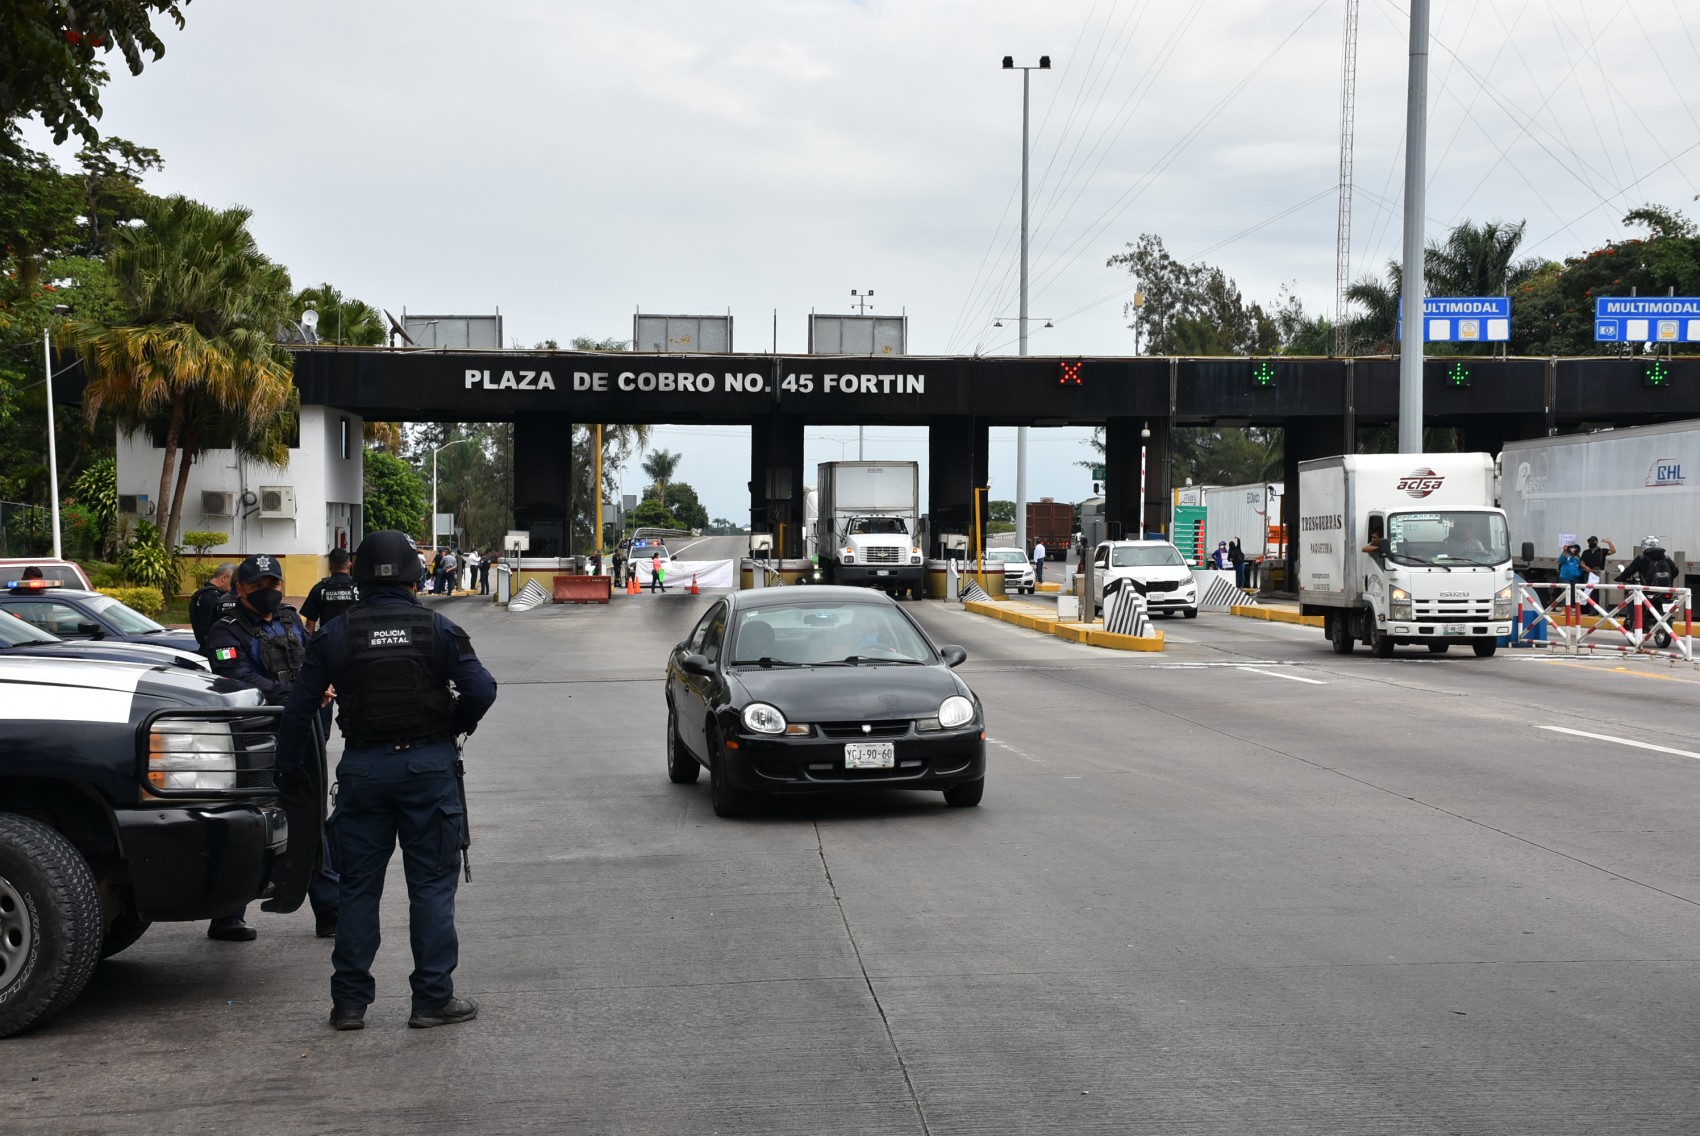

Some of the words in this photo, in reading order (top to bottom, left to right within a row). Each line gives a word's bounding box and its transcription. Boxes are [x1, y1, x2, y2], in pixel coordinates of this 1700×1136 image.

[1424, 302, 1499, 313] ULTIMODAL
[1607, 302, 1700, 314] MULTIMODAL
[465, 370, 556, 390] PLAZA
[573, 372, 609, 391] DE
[617, 372, 715, 392] COBRO
[724, 373, 771, 392] NO.
[781, 374, 814, 393] 45
[823, 374, 925, 394] FORTIN
[1301, 514, 1342, 532] TRESGUERRAS
[373, 630, 406, 638] POLICIA
[371, 637, 409, 646] ESTATAL
